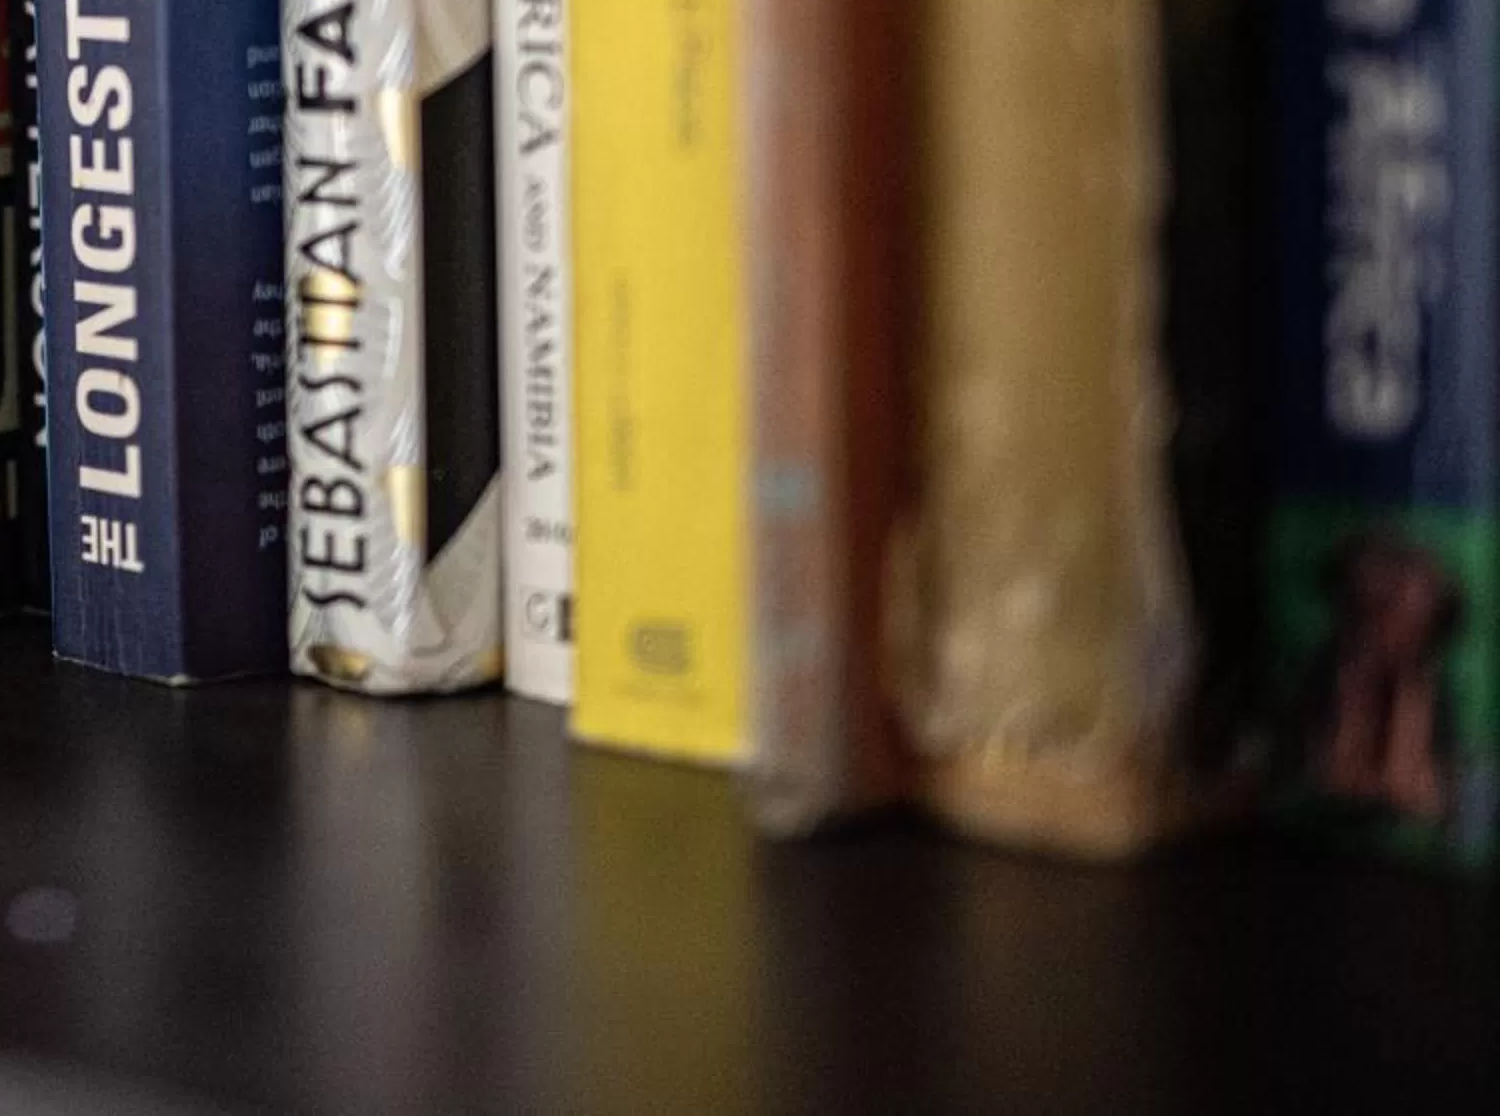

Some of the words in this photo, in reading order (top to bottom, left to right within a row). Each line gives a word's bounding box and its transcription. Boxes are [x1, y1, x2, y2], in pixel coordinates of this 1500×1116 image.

[522, 176, 550, 254] AND
[300, 156, 366, 610] SEBASTIAN
[523, 262, 558, 483] NAMIBIA
[80, 516, 145, 573] THE
